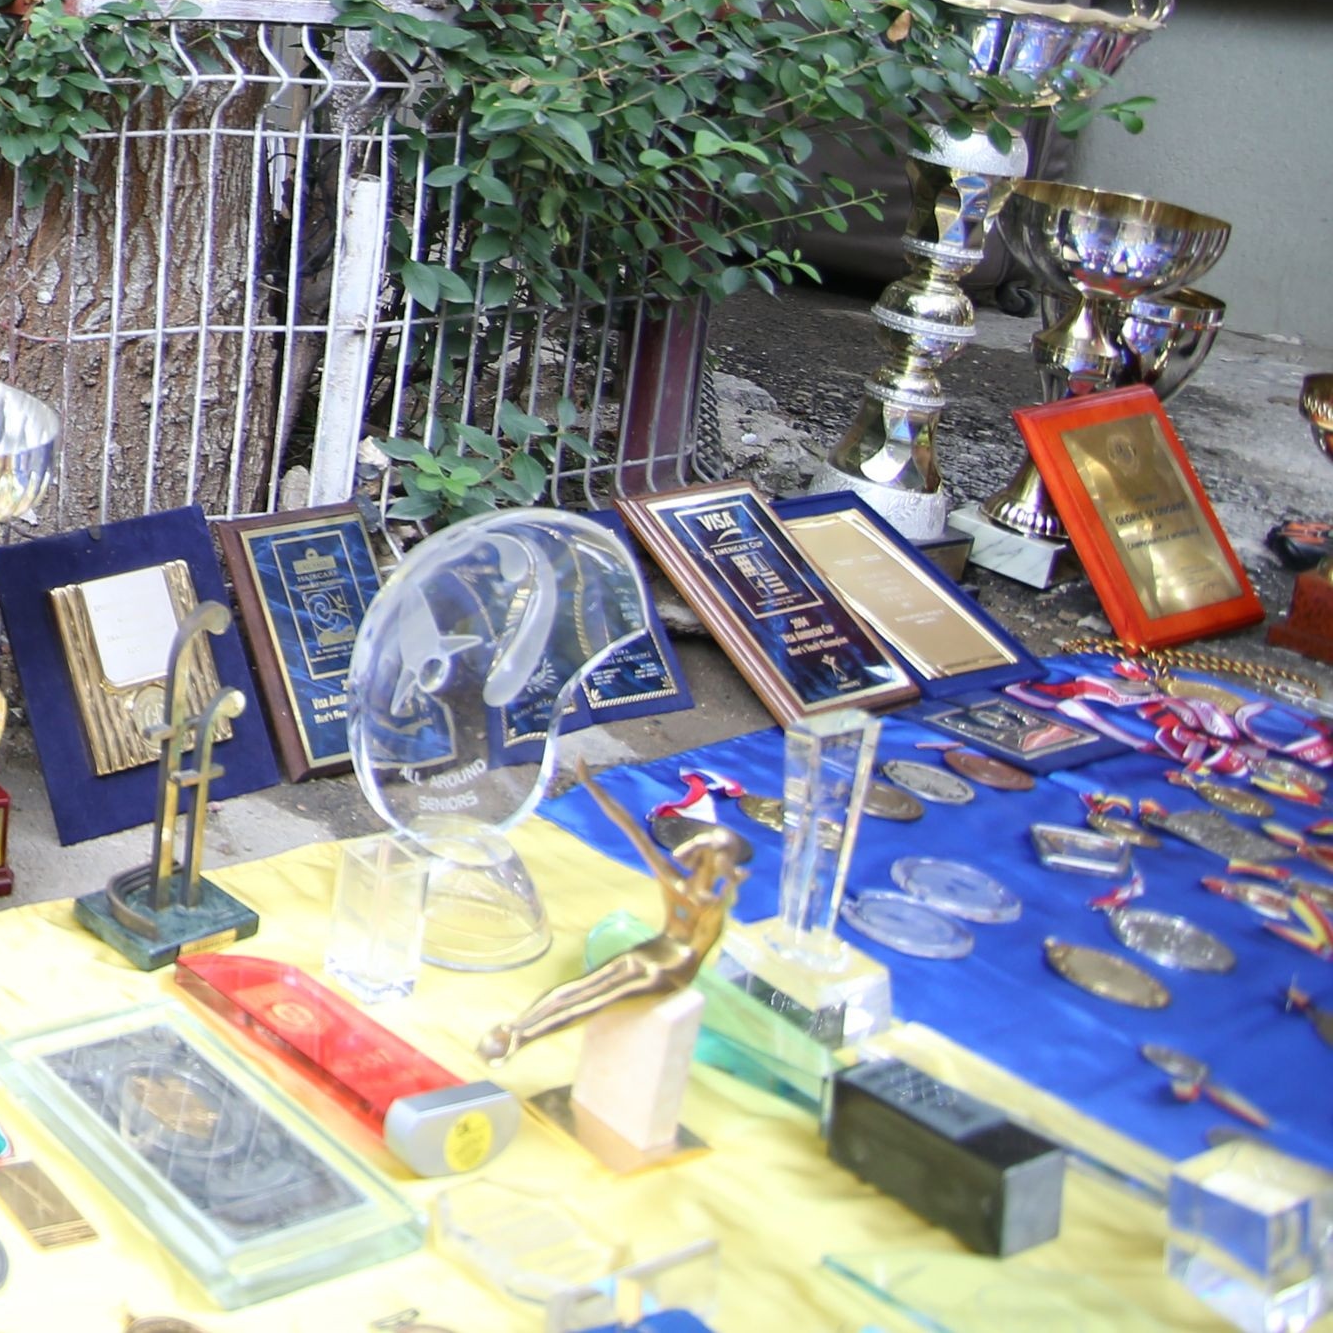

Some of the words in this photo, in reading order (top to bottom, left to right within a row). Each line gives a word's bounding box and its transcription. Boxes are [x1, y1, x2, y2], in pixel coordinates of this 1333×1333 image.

[696, 511, 737, 531] VISA
[713, 543, 749, 556] AMERICAN
[748, 540, 764, 549] CUP
[399, 765, 423, 787] ALL
[429, 758, 487, 789] AROUND
[418, 789, 479, 812] SENIORS
